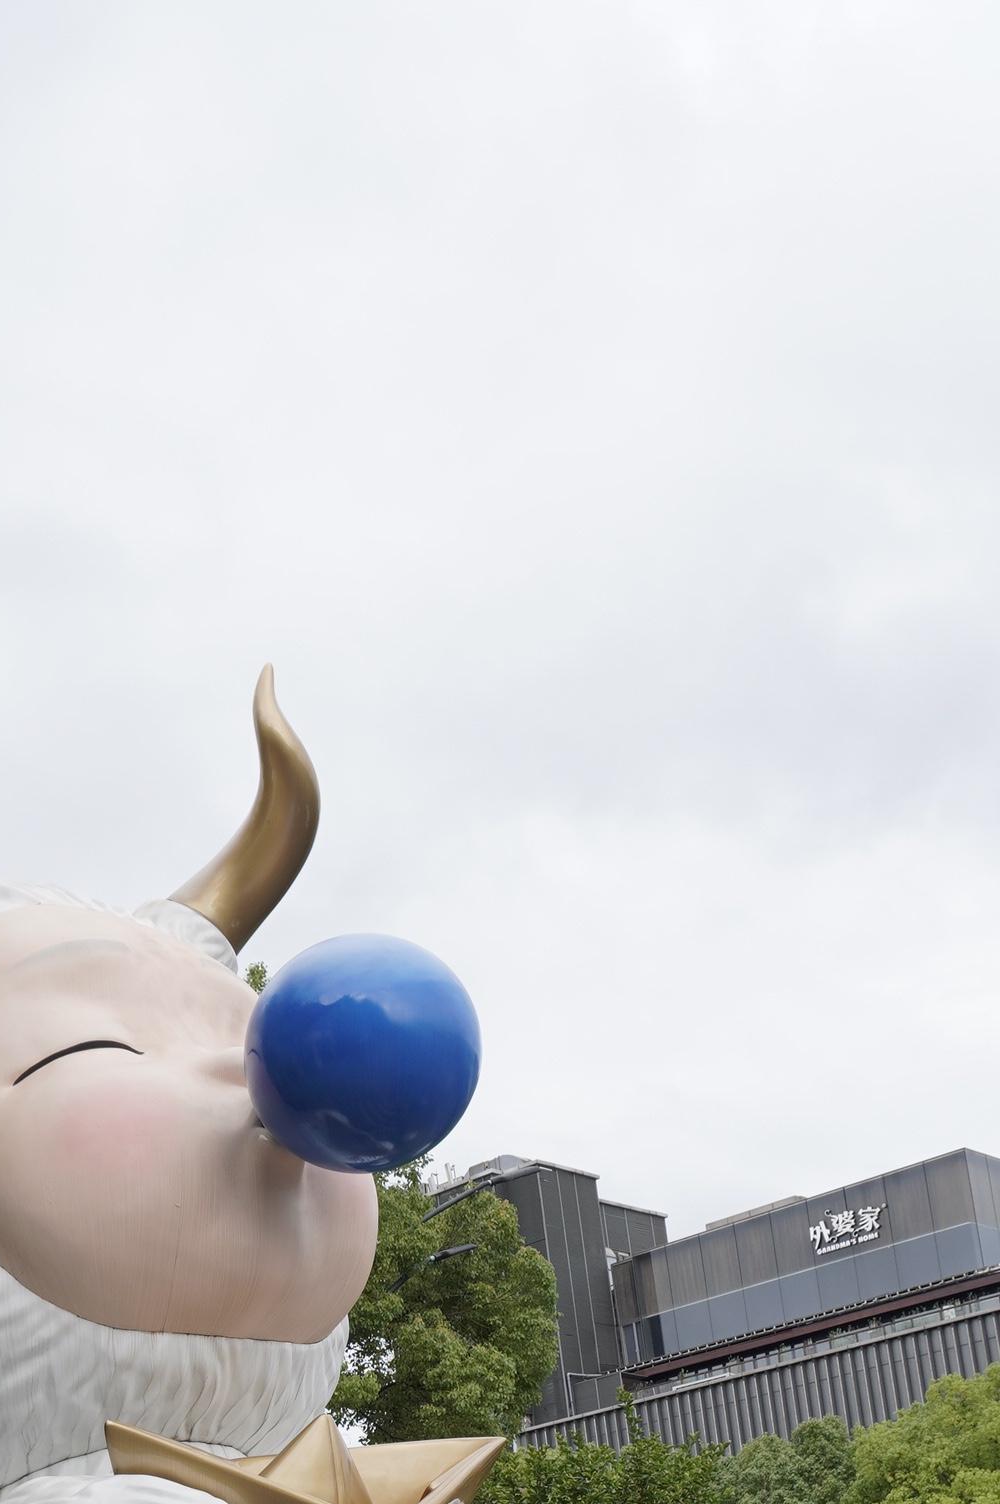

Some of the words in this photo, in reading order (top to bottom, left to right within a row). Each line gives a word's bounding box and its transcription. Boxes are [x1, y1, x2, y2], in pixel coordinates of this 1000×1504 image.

[809, 1206, 880, 1250] 外婆家
[857, 1231, 878, 1243] HOME
